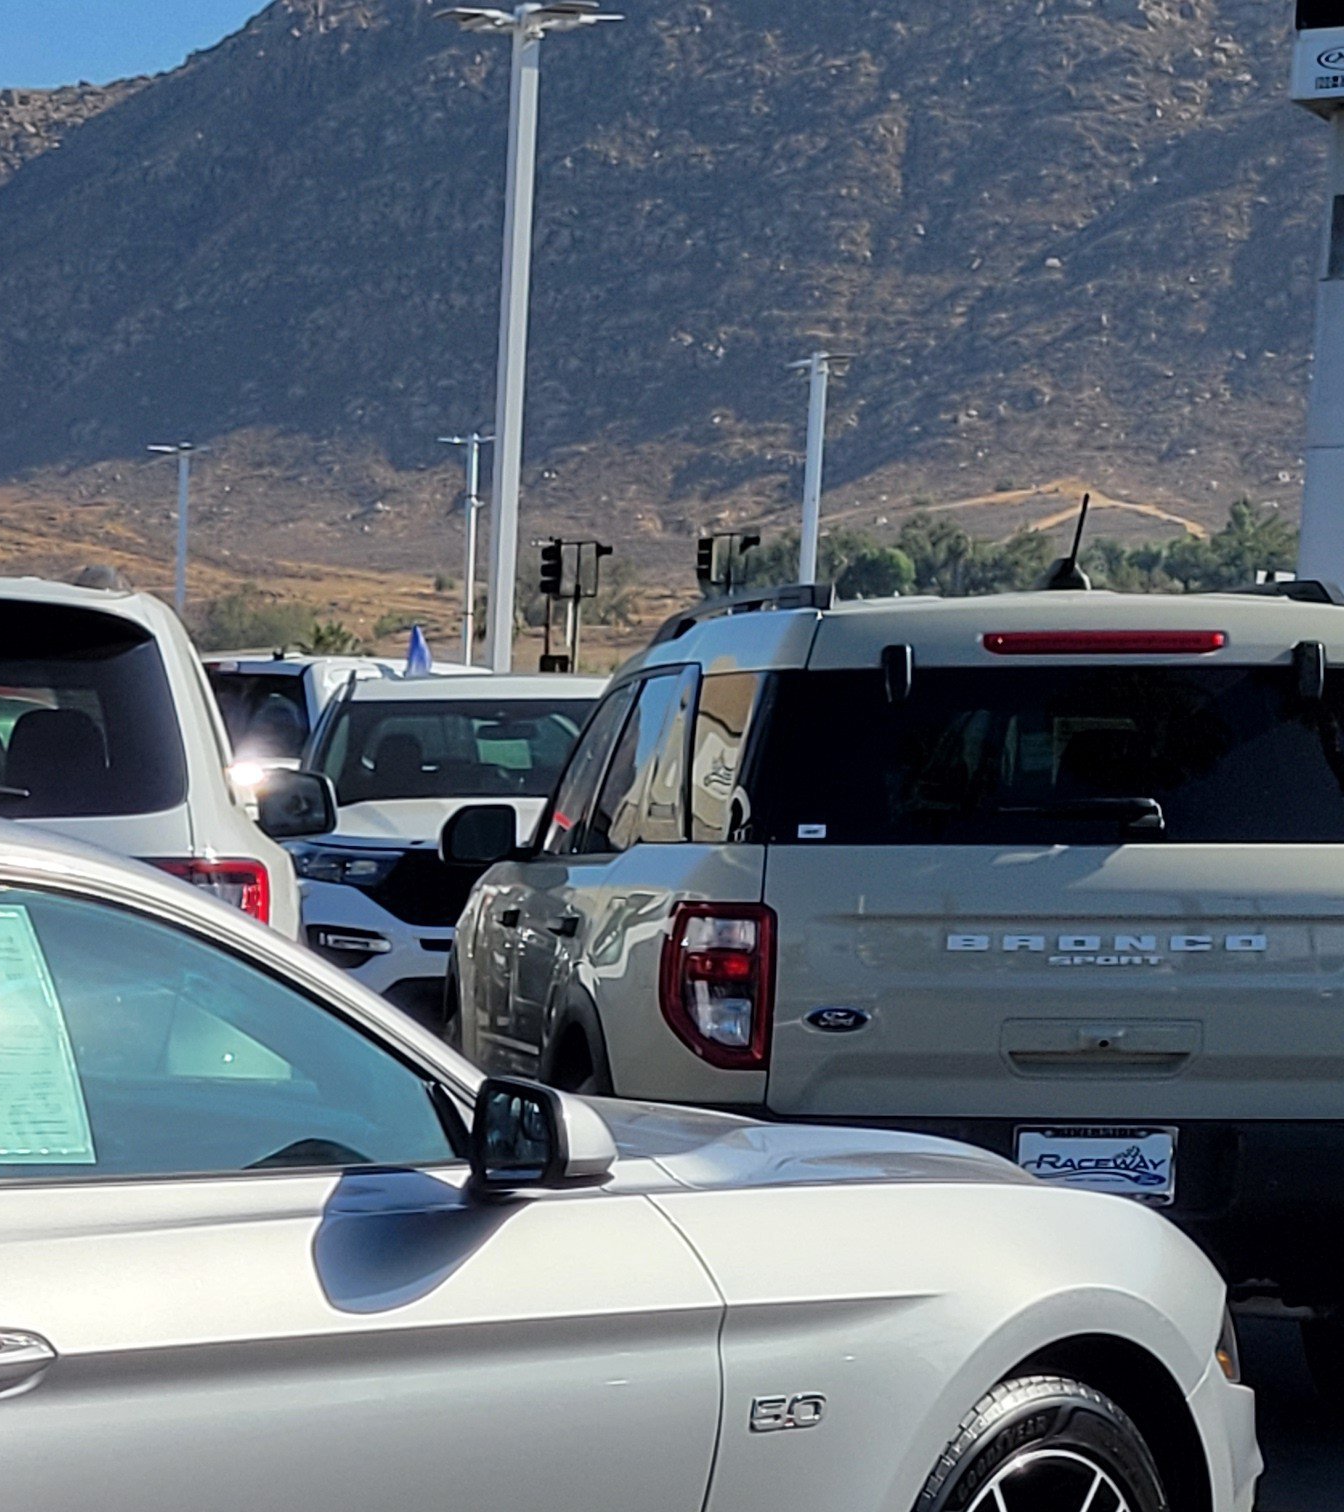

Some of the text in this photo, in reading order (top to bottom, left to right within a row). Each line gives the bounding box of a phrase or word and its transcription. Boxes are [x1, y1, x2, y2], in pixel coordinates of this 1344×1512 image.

[946, 934, 1268, 952] BRONCO
[1048, 955, 1164, 967] SPORT
[1036, 1153, 1166, 1171] RACEWAY
[749, 1391, 828, 1434] 5.0
